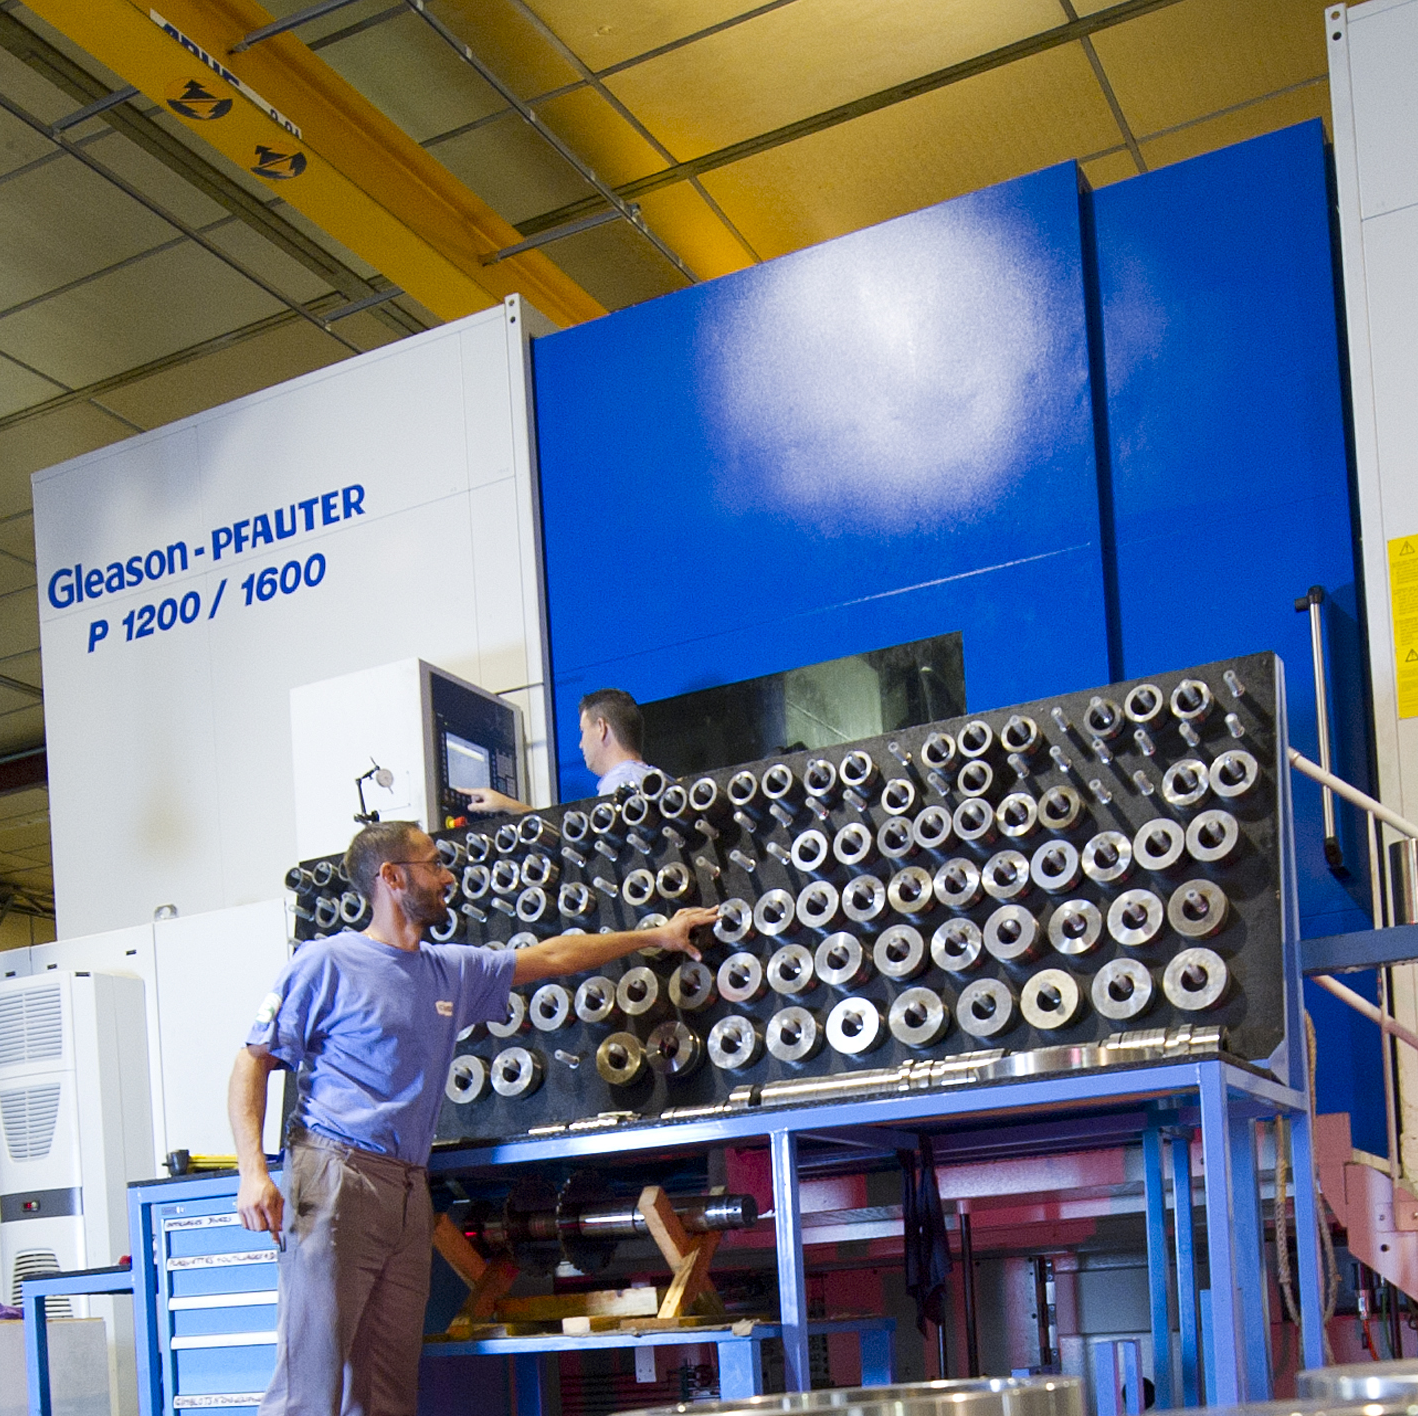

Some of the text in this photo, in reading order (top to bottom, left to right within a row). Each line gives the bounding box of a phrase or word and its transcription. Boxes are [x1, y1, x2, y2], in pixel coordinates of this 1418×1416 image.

[47, 541, 188, 609] Gleason
[212, 484, 365, 561] PFAUTER
[87, 619, 109, 654] P
[122, 590, 201, 642] 1200
[241, 552, 326, 607] 1600
